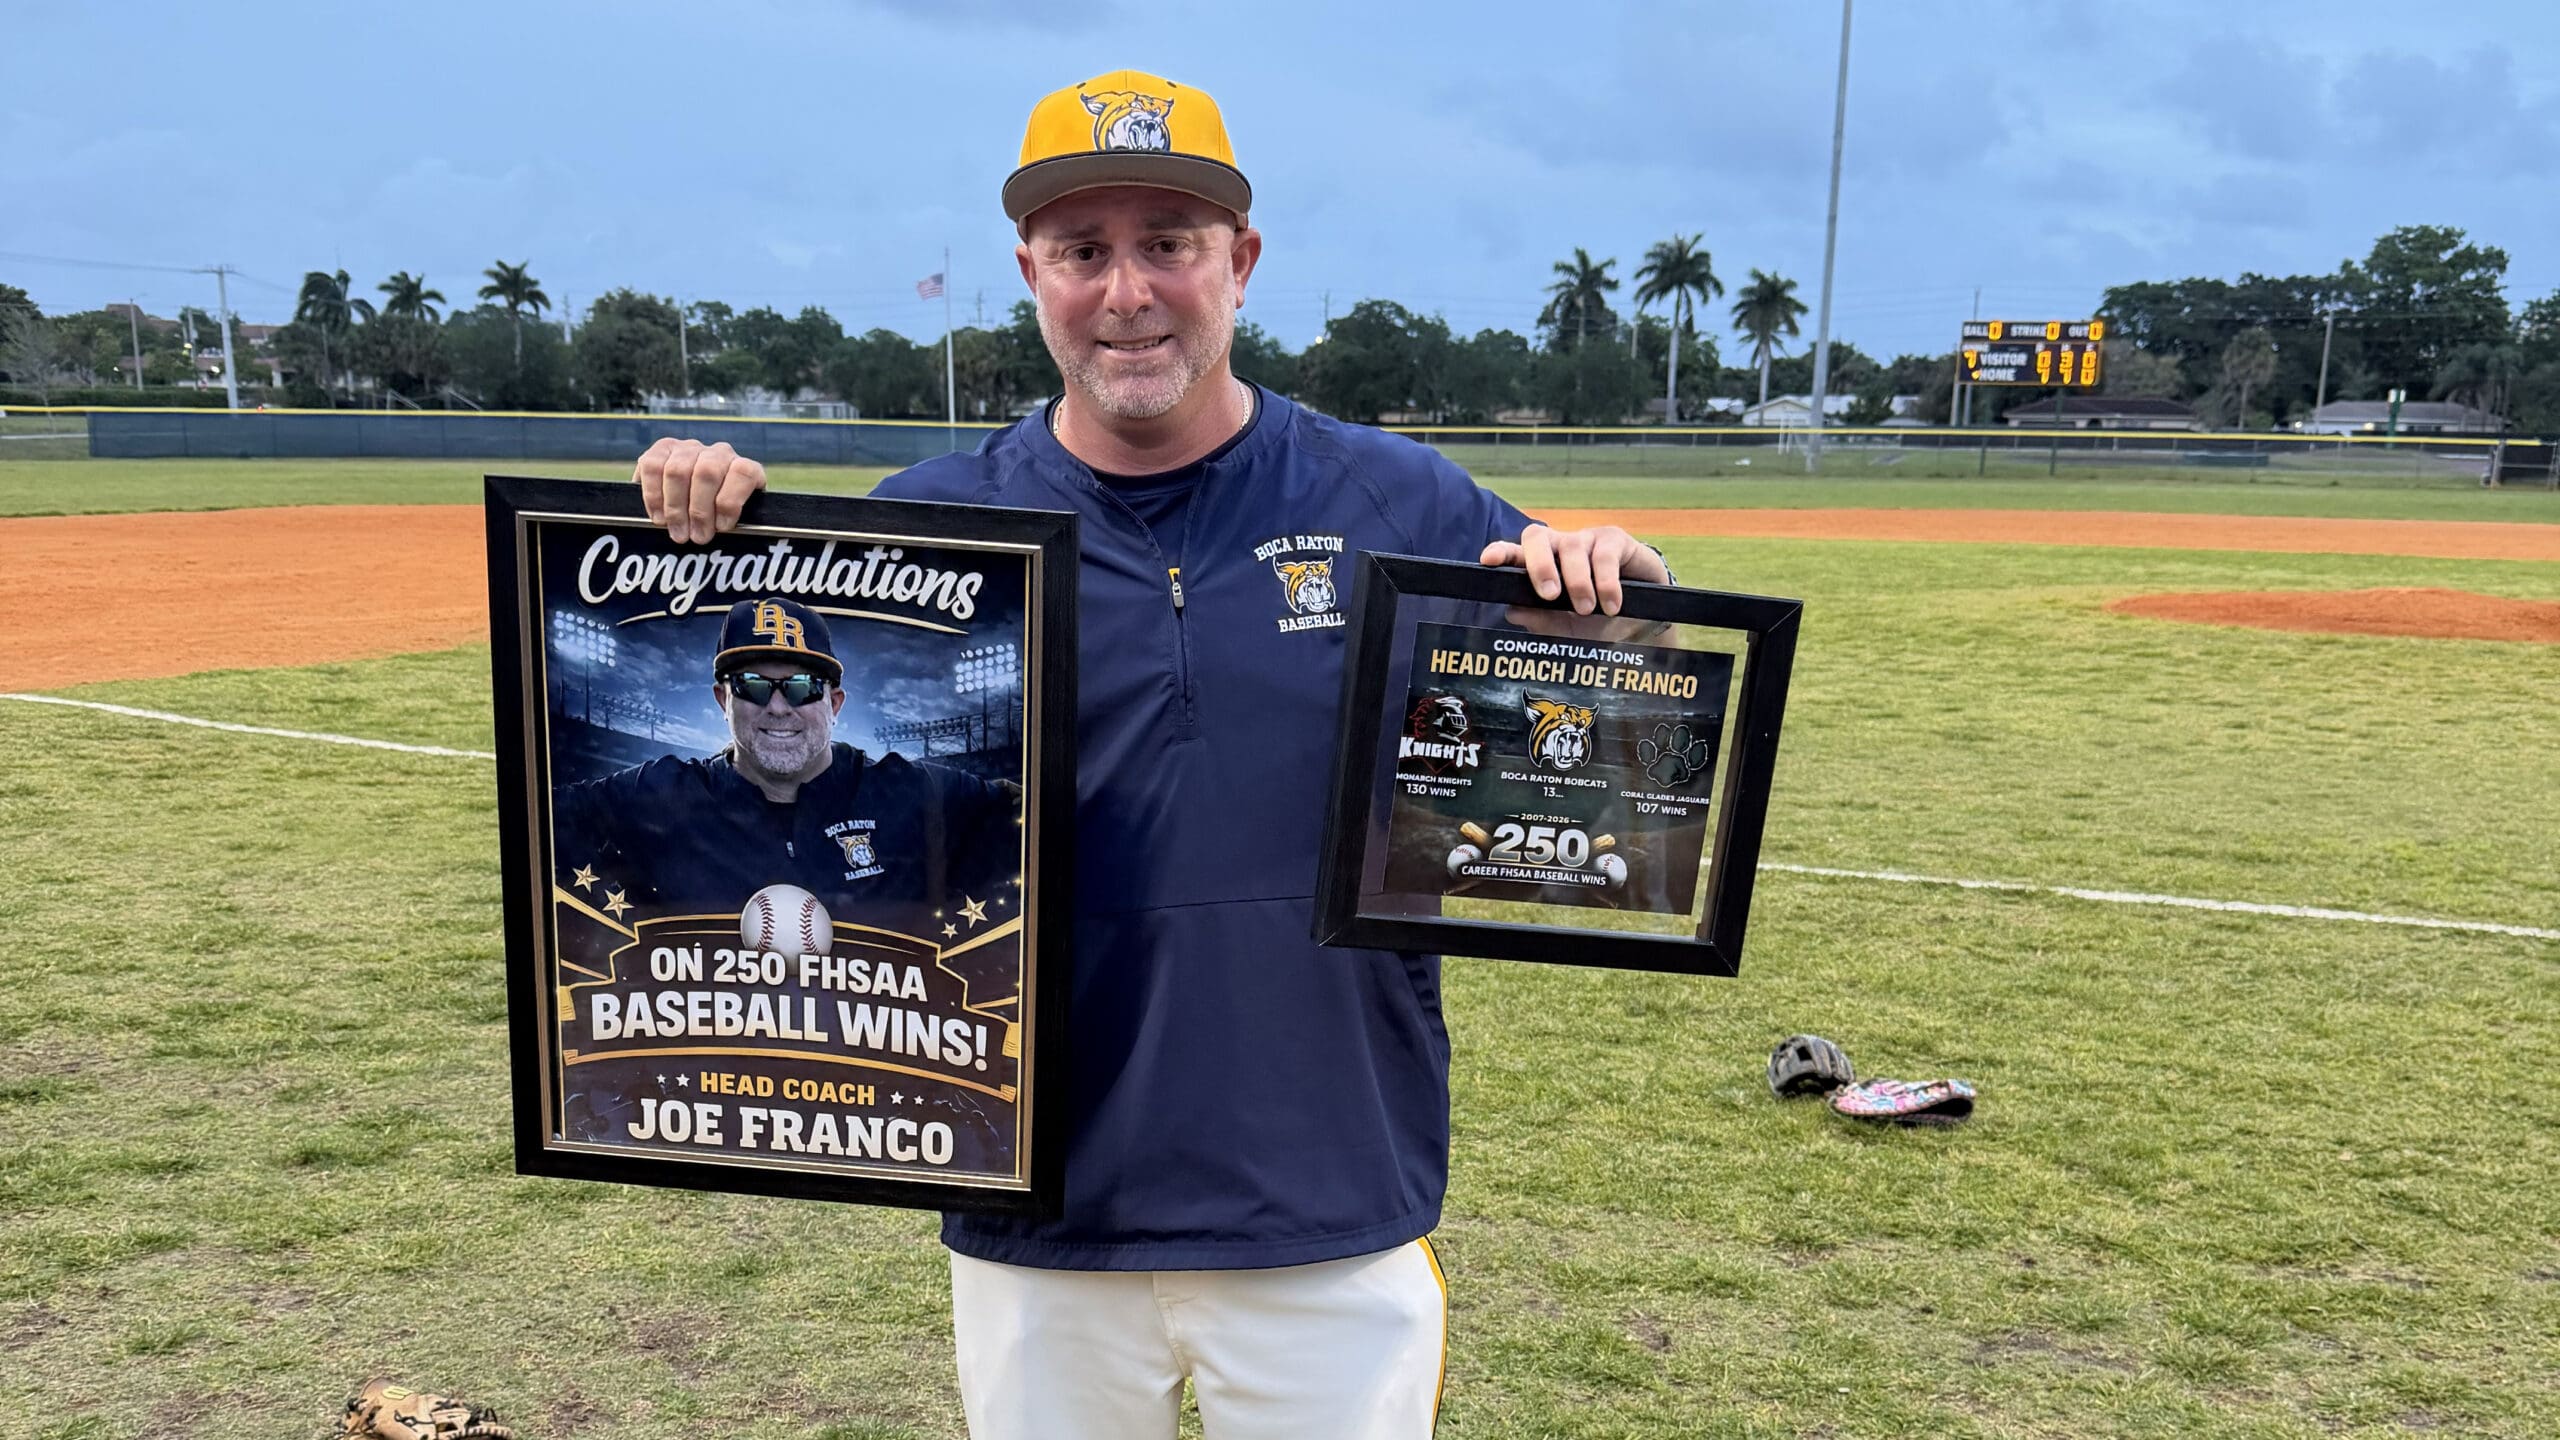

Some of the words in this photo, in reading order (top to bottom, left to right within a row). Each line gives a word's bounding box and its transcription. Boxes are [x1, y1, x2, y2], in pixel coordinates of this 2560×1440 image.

[1988, 321, 2003, 340] 0
[2046, 321, 2060, 340] 0
[2089, 321, 2103, 340] 0
[1980, 352, 2028, 367] VISITOR
[1979, 368, 2016, 381] HOME
[2081, 367, 2095, 385] 0
[1254, 537, 1293, 561] BOCA
[1295, 535, 1343, 552] RATON
[578, 534, 983, 620] Congratulations
[1278, 612, 1345, 632] BASEBALL
[1494, 639, 1644, 666] CONGRATULATIONS
[1430, 649, 1489, 676] HEAD
[1494, 657, 1565, 683] COACH
[1569, 664, 1607, 687] JOE
[1612, 667, 1698, 699] FRANCO
[1396, 772, 1436, 783] MONARCH
[1437, 776, 1472, 786] KNIGHTS
[1501, 771, 1527, 781] BOCA
[1530, 774, 1562, 784] RATON
[1564, 777, 1608, 788] BOBCATS
[1406, 783, 1427, 794] 130
[1429, 787, 1456, 797] WINS
[1620, 790, 1645, 799] CORAL
[1646, 793, 1675, 802] GLADES
[1676, 796, 1710, 804] JAGUARS
[1521, 813, 1570, 823] 2007-2026
[1636, 802, 1658, 814] 107
[1661, 805, 1687, 816] WINS
[824, 822, 847, 837] BOCA
[847, 819, 876, 830] RATON
[1488, 823, 1590, 868] 250
[844, 864, 885, 881] BASEBALL
[1462, 865, 1498, 876] CAREER
[1500, 867, 1532, 879] FHSAA
[1533, 869, 1579, 883] BASEBALL
[1581, 873, 1606, 886] WINS
[650, 946, 703, 983] ON
[713, 950, 785, 986] 250
[800, 954, 928, 1002] FHSAA
[591, 990, 829, 1043] BASEBALL
[837, 1001, 987, 1071] WINS!
[700, 1071, 774, 1099] HEAD
[782, 1078, 875, 1105] COACH
[627, 1098, 722, 1145] JOE
[740, 1106, 954, 1165] FRANCO
